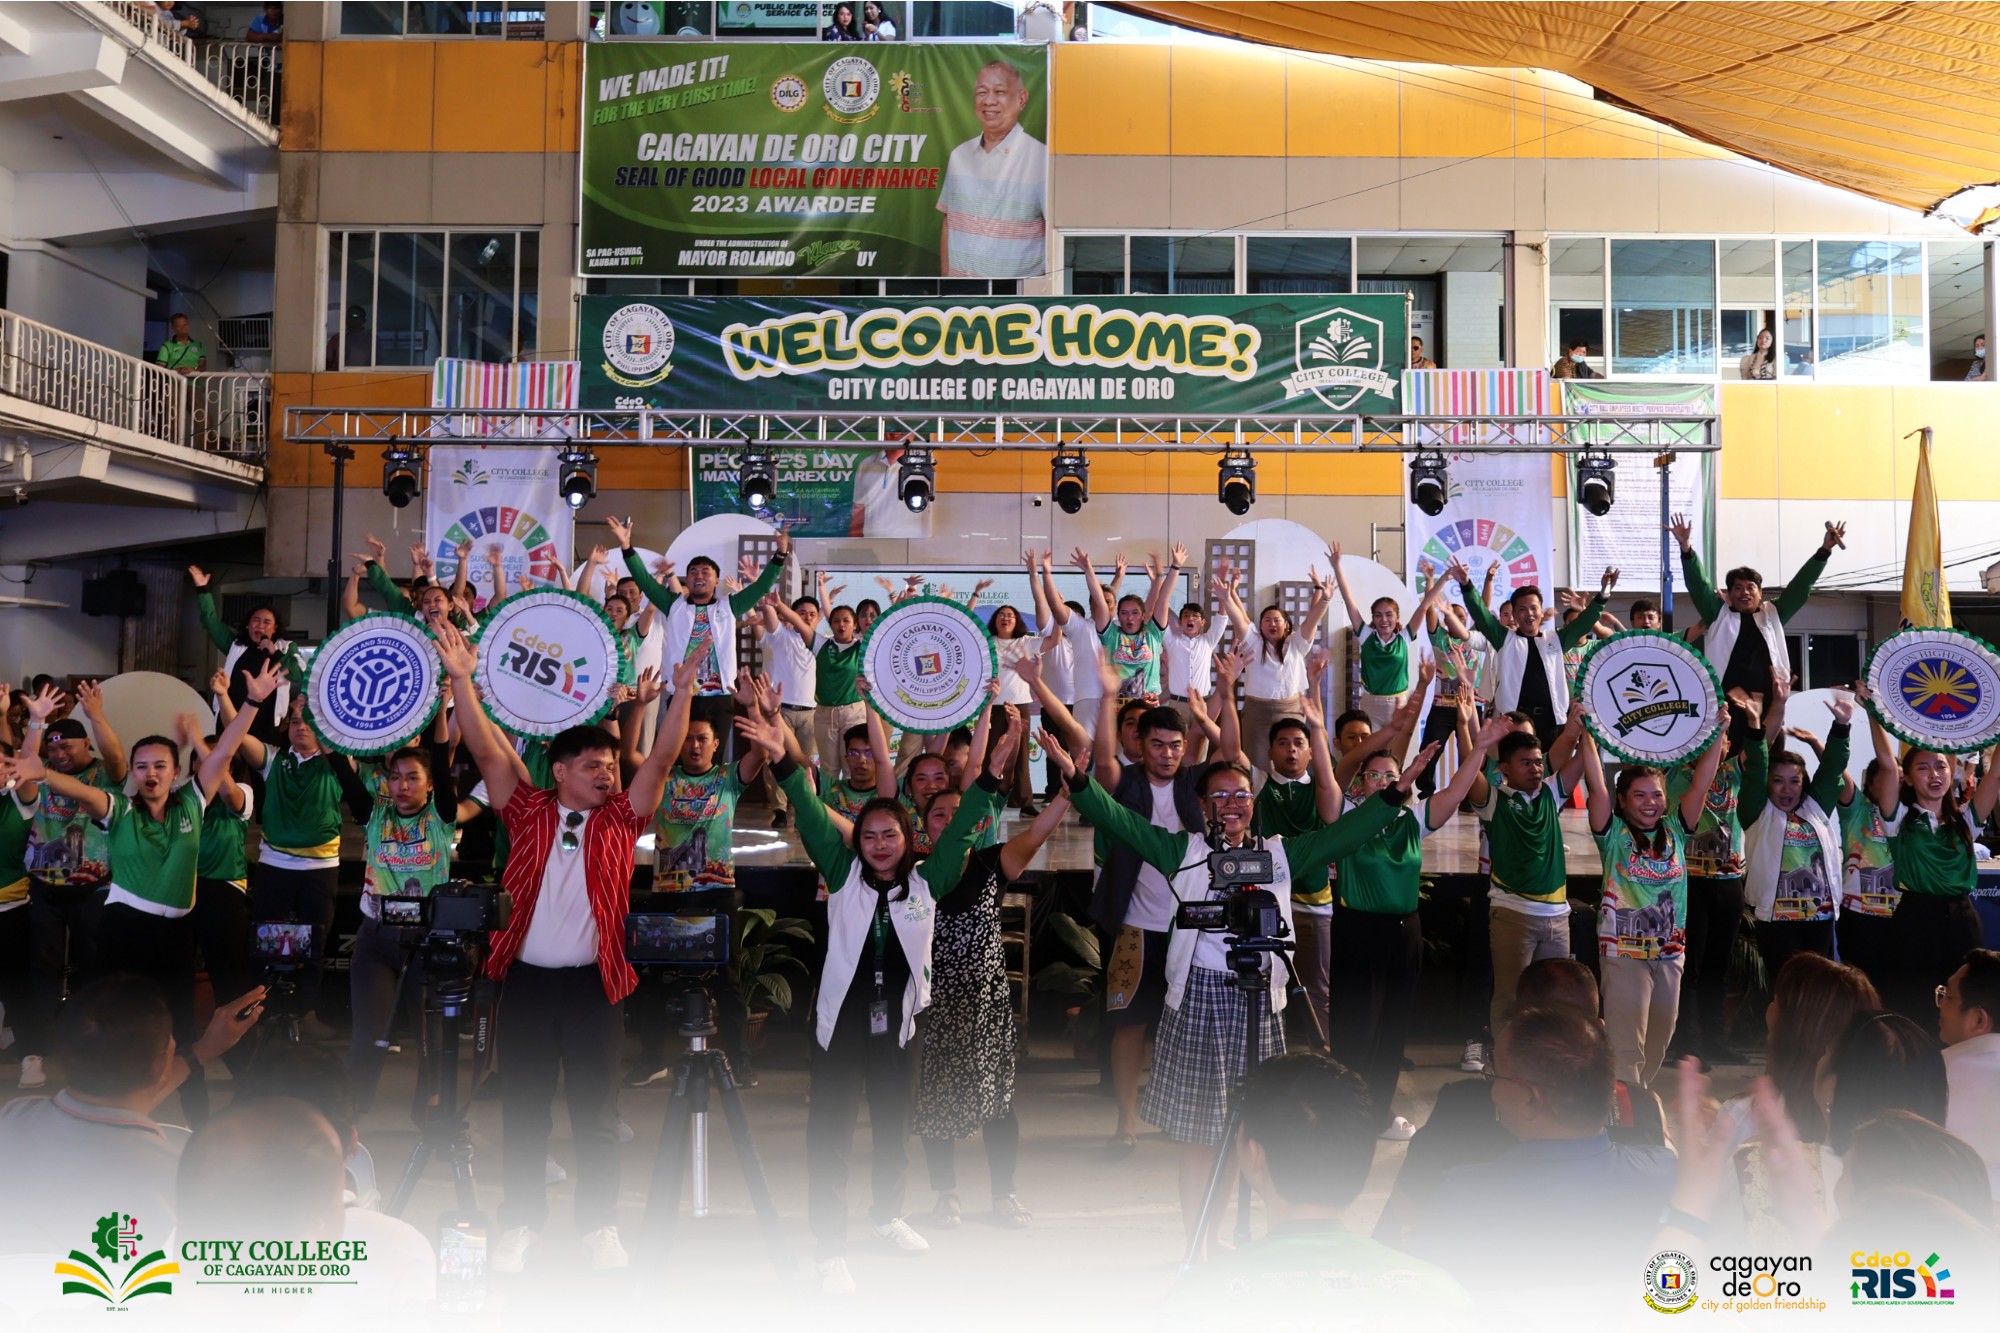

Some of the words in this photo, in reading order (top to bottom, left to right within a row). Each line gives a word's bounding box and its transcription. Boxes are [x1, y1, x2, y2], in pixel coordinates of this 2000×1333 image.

[836, 59, 868, 69] CAGAYAN
[599, 74, 634, 102] WE
[635, 61, 697, 95] MADE
[699, 55, 730, 83] IT!
[592, 106, 617, 127] FOR
[620, 103, 644, 121] THE
[647, 94, 679, 116] VERY
[681, 86, 720, 109] FIRST
[721, 76, 758, 101] TIME!
[779, 89, 800, 98] DILG
[637, 133, 758, 162] CAGAYAN
[761, 134, 798, 163] DE
[801, 134, 858, 163] ORO
[862, 134, 927, 163] CITY
[615, 167, 659, 188] SEAL
[664, 167, 688, 188] OF
[691, 167, 746, 189] GOOD
[748, 167, 808, 189] LOCAL
[811, 168, 939, 189] GOVERNANCE
[690, 195, 749, 213] 2023
[755, 196, 877, 213] AWARDEE
[694, 240, 715, 248] UNDER
[715, 240, 727, 248] THE
[727, 240, 779, 248] ADMINISTRATION
[779, 239, 789, 248] OF
[586, 248, 596, 257] SA
[678, 250, 727, 266] MAYOR
[728, 250, 796, 267] ROLANDO
[797, 239, 861, 267] Klarex
[856, 251, 877, 267] UY
[588, 257, 620, 267] KAUBAN
[620, 257, 630, 266] TA
[630, 256, 644, 266] UY!
[609, 316, 619, 327] OF
[620, 305, 660, 317] CAGAYAN
[659, 317, 670, 328] DE
[665, 331, 673, 351] ORO
[724, 309, 1040, 377] WELCOME
[1046, 309, 1258, 378] HOME!
[616, 360, 660, 373] PHILIPPINES
[1296, 370, 1325, 383] CITY
[1329, 368, 1384, 383] COLLEGE
[828, 377, 877, 400] CITY
[881, 377, 969, 400] COLLEGE
[972, 377, 998, 400] OF
[1001, 377, 1096, 400] CAGAYAN
[1100, 377, 1127, 400] DE
[1132, 377, 1175, 400] ORO
[615, 396, 644, 405] CdeO
[813, 454, 859, 469] DAY
[491, 468, 510, 476] CITY
[512, 468, 549, 476] COLLEGE
[830, 471, 853, 482] UY
[1464, 479, 1484, 487] CITY
[1486, 479, 1524, 487] COLLEGE
[470, 570, 522, 583] GOLS
[902, 624, 944, 640] CAGAYAN
[944, 632, 957, 643] DE
[360, 639, 376, 650] AND
[377, 637, 400, 648] SKILLS
[512, 626, 564, 659] CdeO
[894, 640, 903, 652] OF
[330, 645, 360, 682] EDUCATION
[507, 641, 562, 686] RIS
[954, 645, 963, 665] ORO
[1901, 653, 1917, 667] ON
[1919, 650, 1967, 665] HIGHER
[400, 643, 421, 690] DEVELOPMENT
[892, 654, 902, 675] CITY
[909, 677, 954, 694] PHILIPPINES
[1889, 666, 1921, 722] COMMISSION
[1967, 662, 1993, 718] EDUCATION
[330, 683, 348, 720] TECHNICAL
[386, 689, 419, 723] AUTHORITY
[1622, 709, 1642, 725] CITY
[1644, 701, 1688, 714] COLLEGE
[355, 721, 374, 729] 1994
[477, 1017, 488, 1052] Canon
